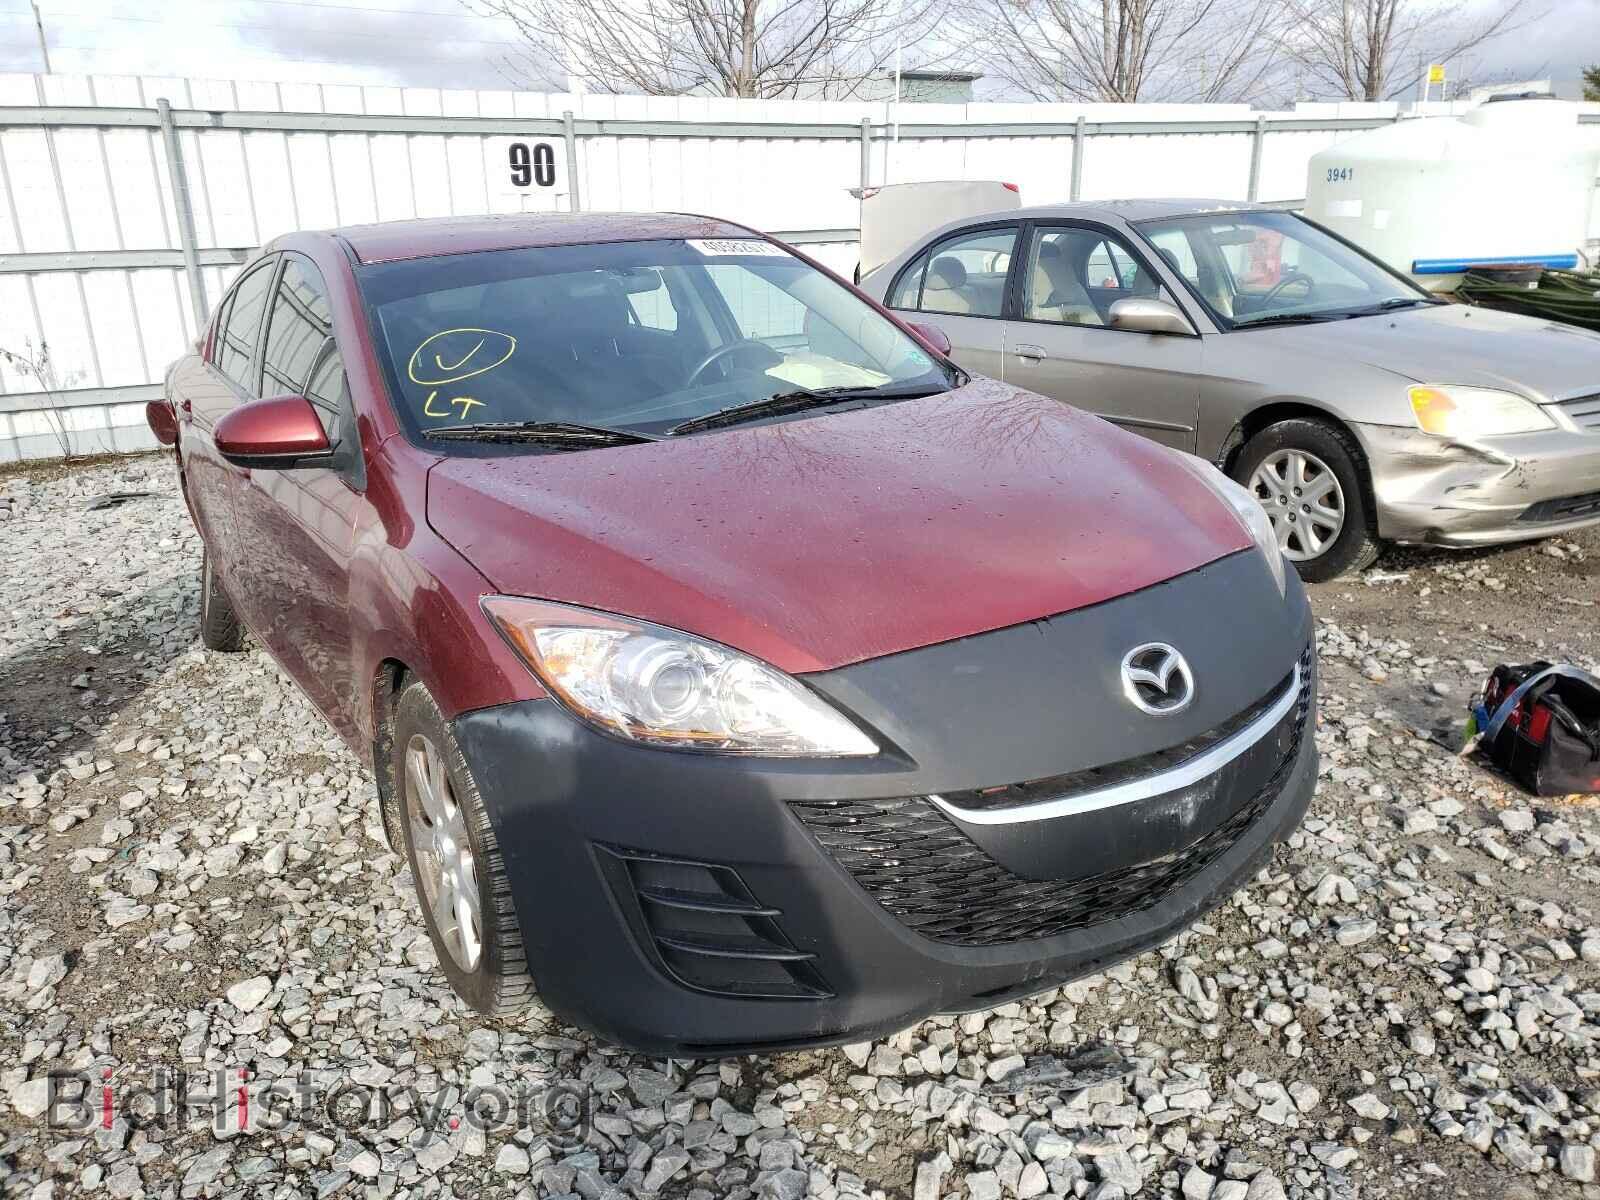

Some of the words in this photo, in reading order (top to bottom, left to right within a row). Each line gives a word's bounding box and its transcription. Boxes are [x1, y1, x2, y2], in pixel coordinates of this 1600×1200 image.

[509, 143, 555, 186] 90
[1327, 168, 1353, 182] 3941
[424, 391, 487, 419] LT
